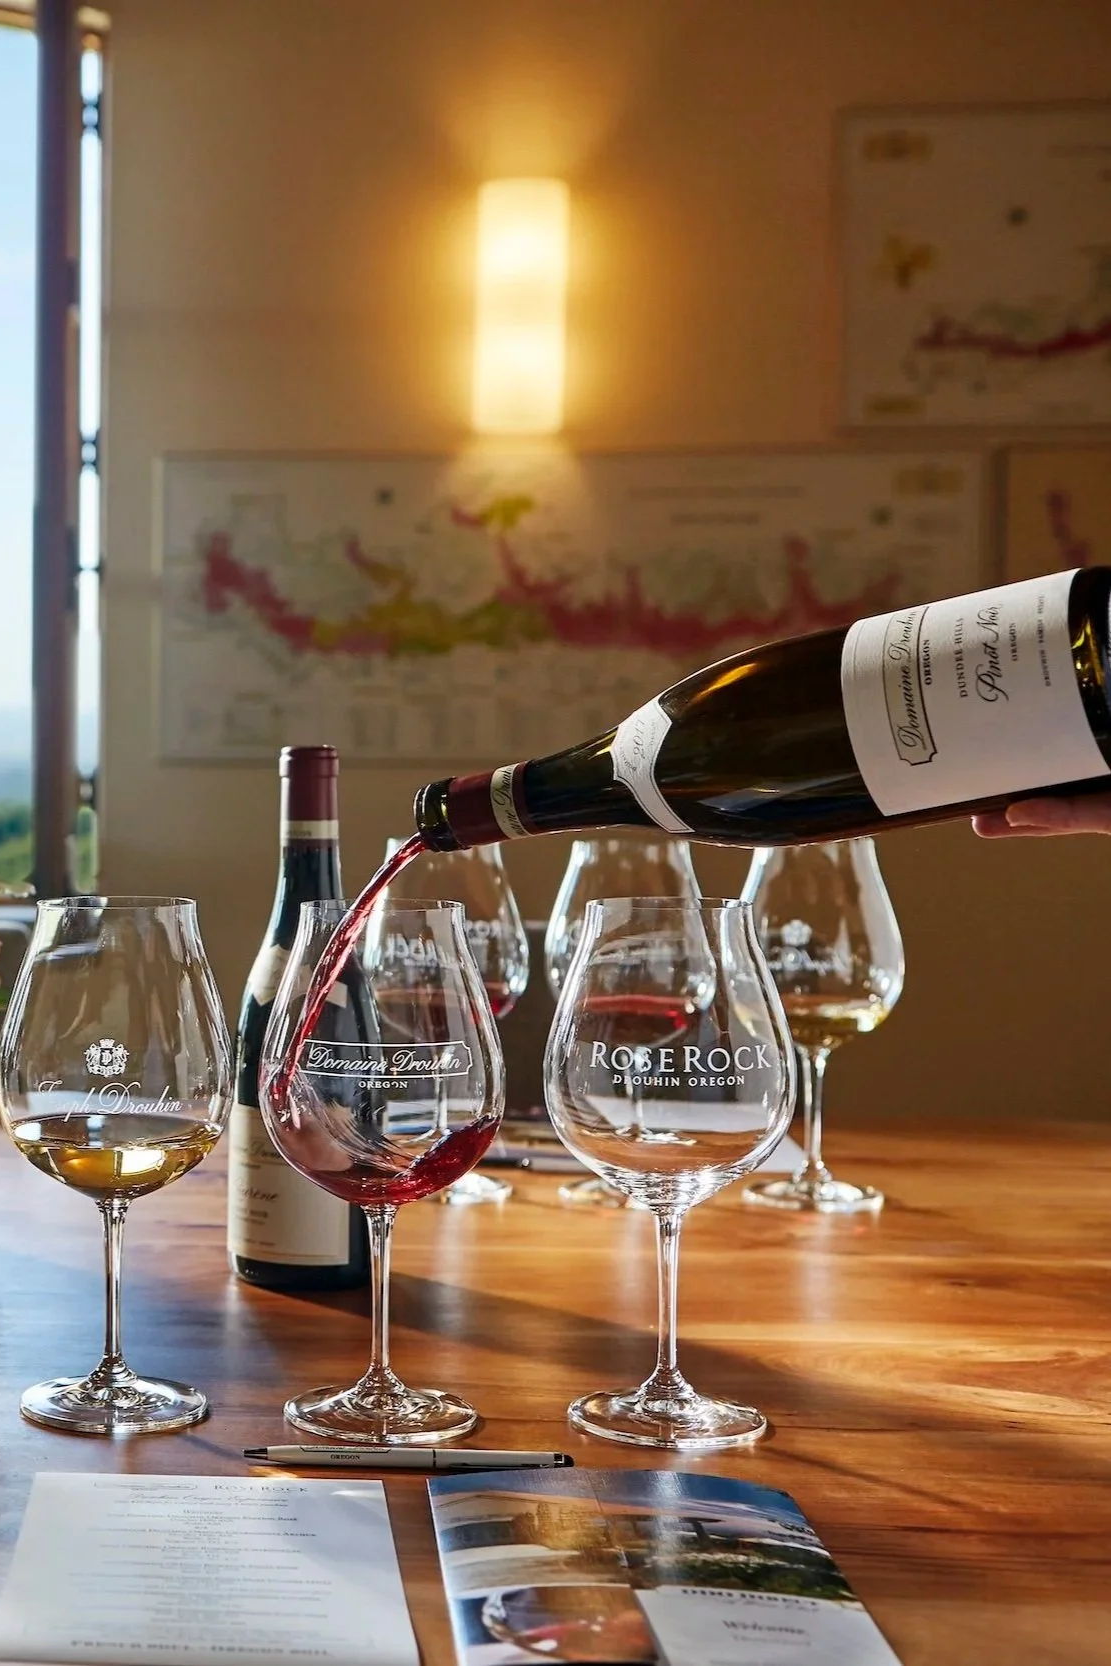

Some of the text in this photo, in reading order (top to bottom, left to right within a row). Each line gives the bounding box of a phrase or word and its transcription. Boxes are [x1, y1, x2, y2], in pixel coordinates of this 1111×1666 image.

[923, 639, 933, 685] OREGON
[954, 617, 968, 698] DUNDEE HILLS
[975, 603, 1009, 702] Pinot Noir
[1008, 622, 1017, 661] OREGON
[889, 610, 927, 750] Domaine Drouhin
[632, 718, 646, 760] 2017
[308, 1046, 387, 1073] Domaine
[96, 1081, 183, 1115] Drouhin
[688, 1075, 745, 1087] OREGON
